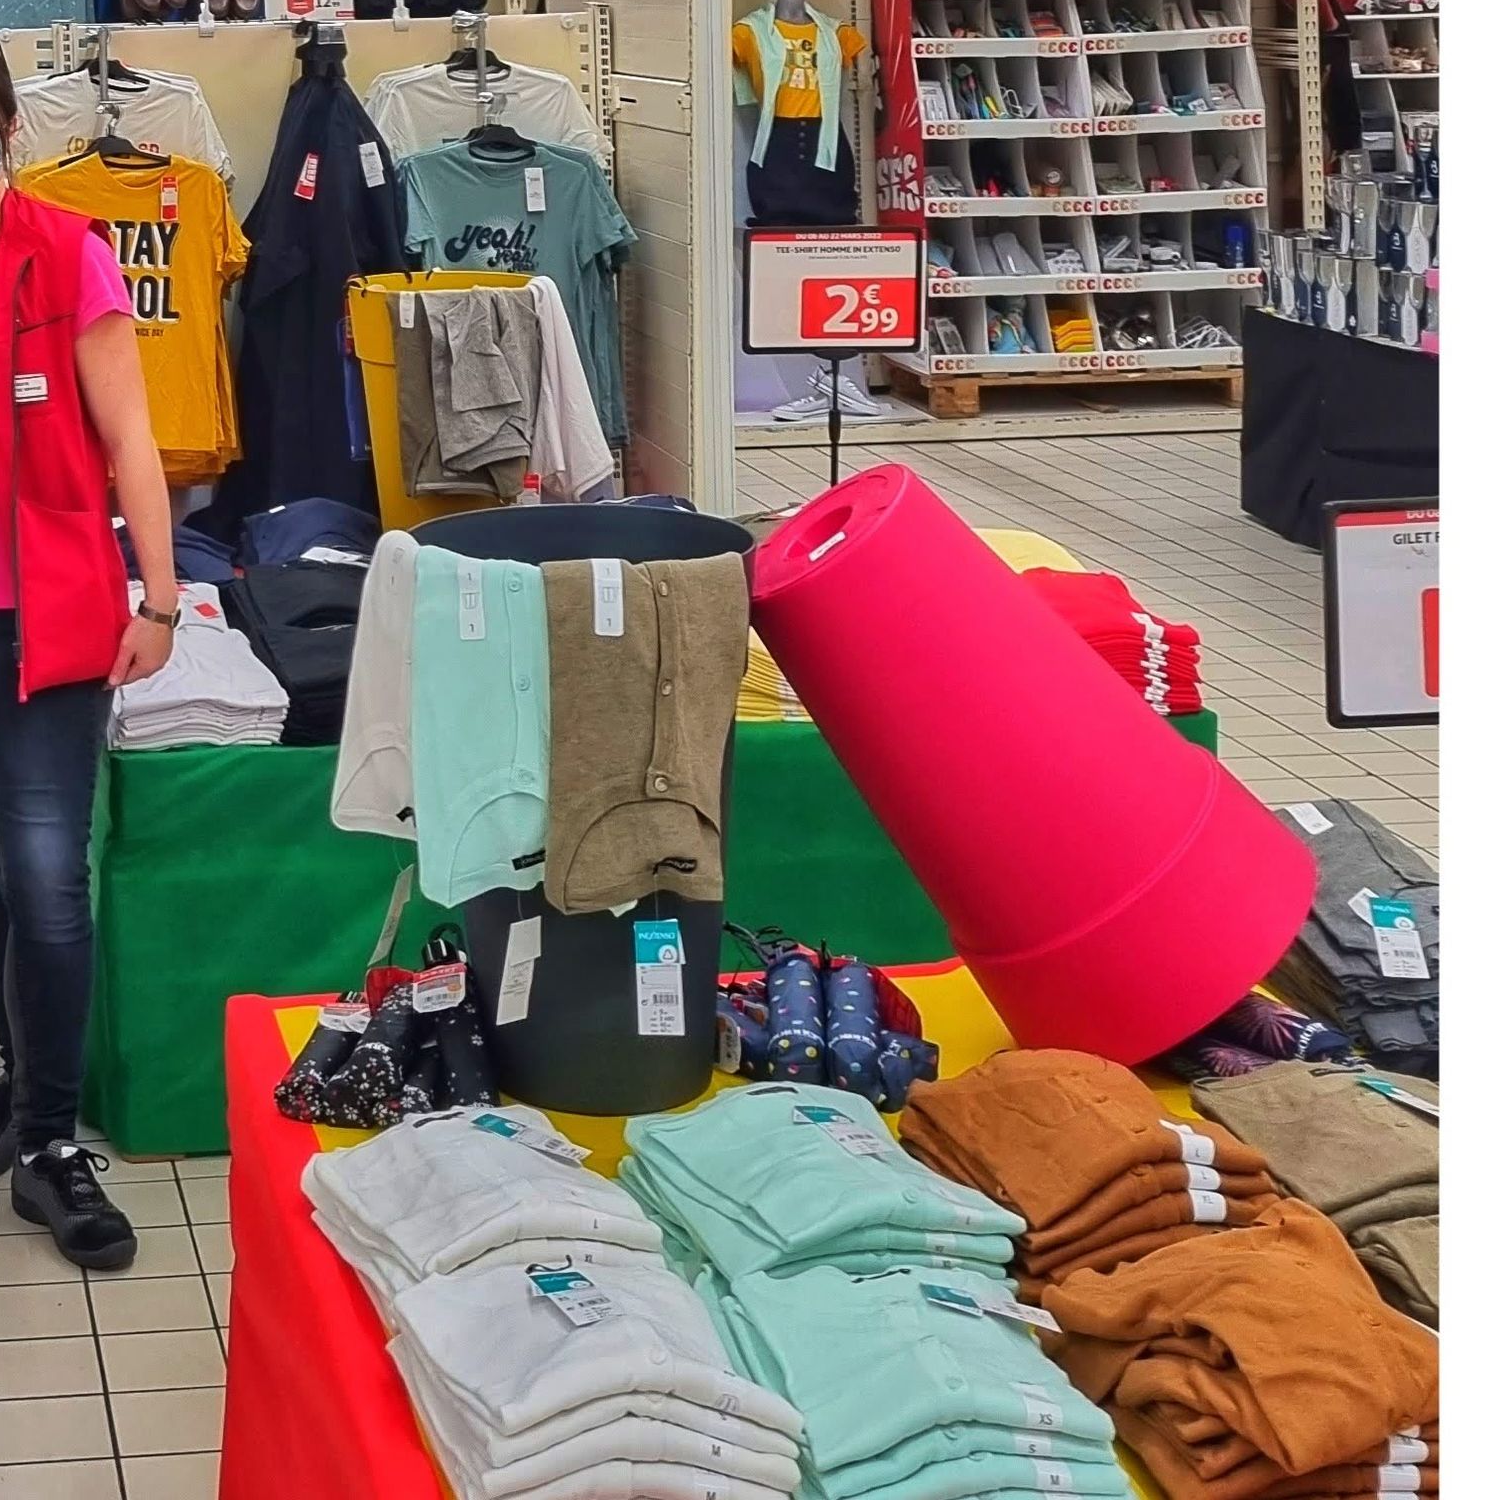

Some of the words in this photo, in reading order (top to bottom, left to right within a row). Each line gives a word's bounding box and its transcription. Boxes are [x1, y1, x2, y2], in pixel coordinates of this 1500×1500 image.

[108, 219, 180, 270] TAY
[444, 220, 536, 262] yeah!
[863, 245, 901, 253] EXTENSO
[122, 274, 181, 323] OL
[1393, 531, 1432, 545] GILET
[1038, 1414, 1053, 1425] XS
